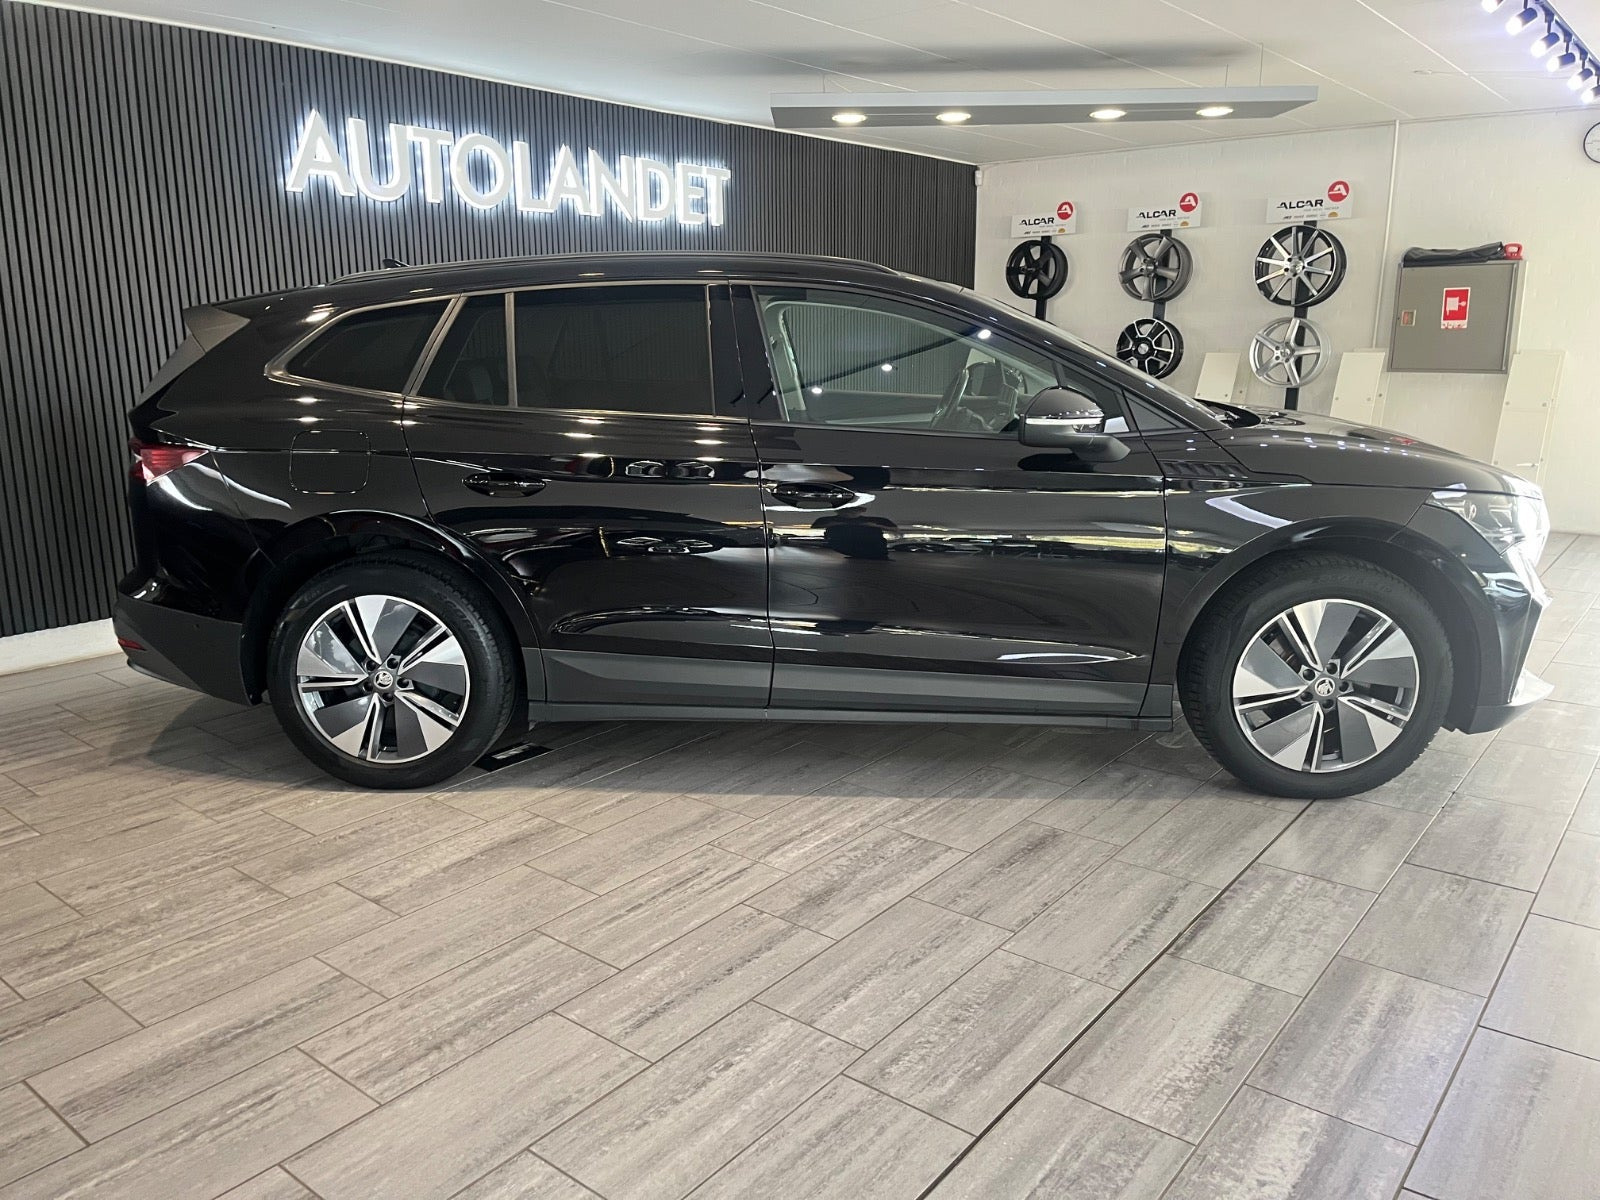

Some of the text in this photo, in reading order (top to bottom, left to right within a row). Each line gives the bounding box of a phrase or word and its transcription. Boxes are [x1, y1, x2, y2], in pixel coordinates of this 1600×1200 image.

[285, 108, 731, 227] AUTOLANDET
[1277, 199, 1324, 210] ALCAR
[1136, 209, 1177, 219] ALCAR
[1019, 217, 1055, 226] ALCAR
